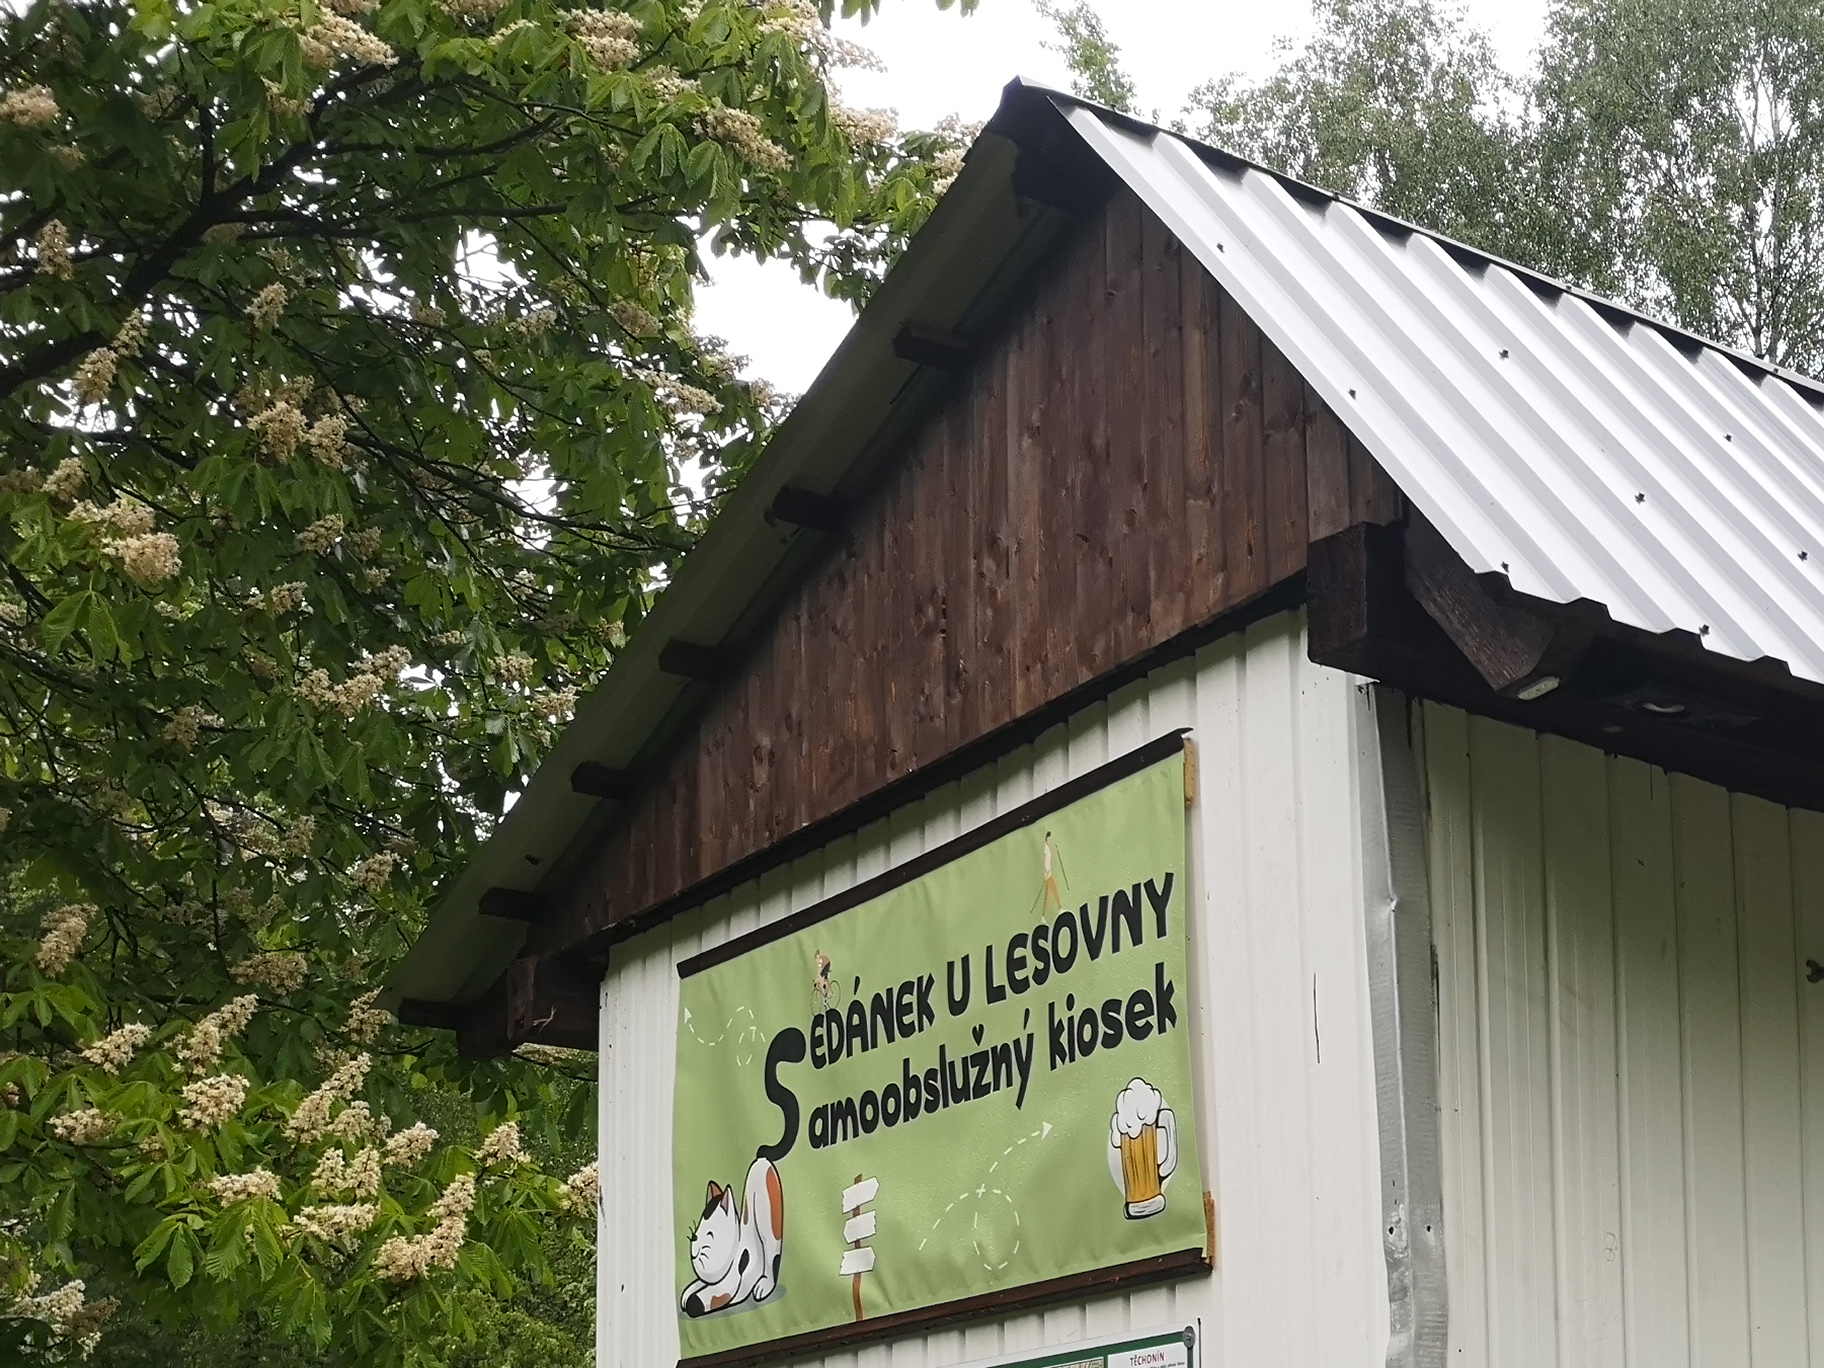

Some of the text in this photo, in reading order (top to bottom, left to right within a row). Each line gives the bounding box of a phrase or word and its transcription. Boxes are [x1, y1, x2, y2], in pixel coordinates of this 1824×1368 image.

[947, 954, 970, 1016] U
[986, 872, 1174, 1005] LESOVNY
[1048, 962, 1177, 1071] kiosek
[1130, 1350, 1165, 1367] TĚCHONÍN
